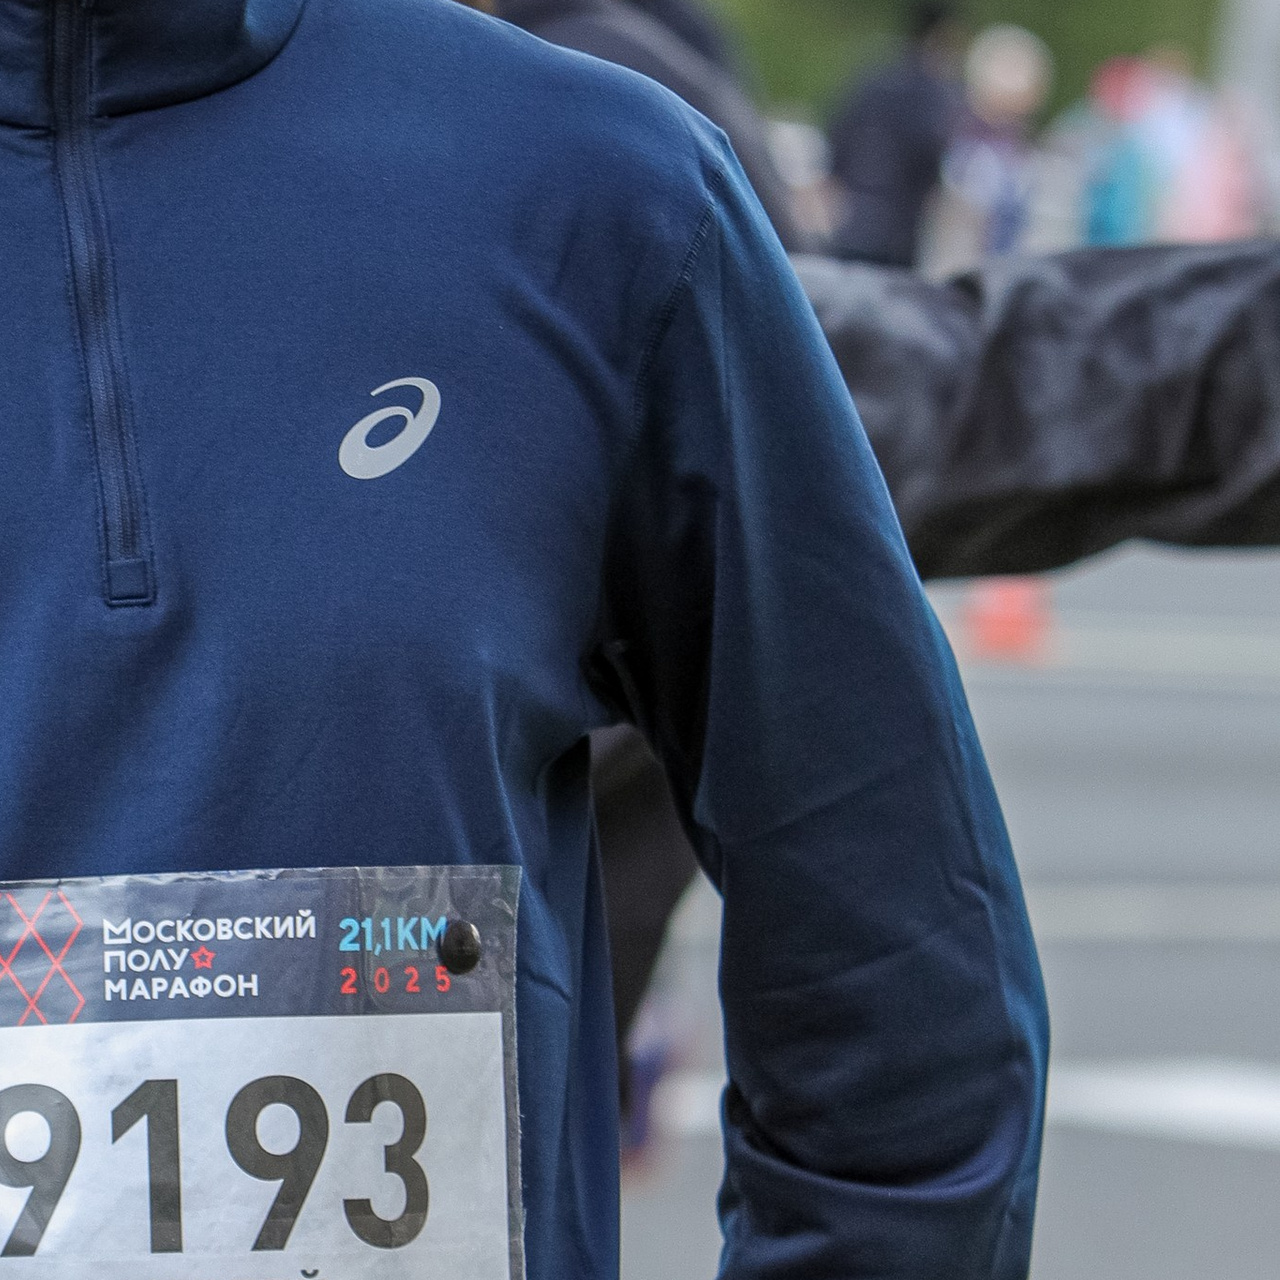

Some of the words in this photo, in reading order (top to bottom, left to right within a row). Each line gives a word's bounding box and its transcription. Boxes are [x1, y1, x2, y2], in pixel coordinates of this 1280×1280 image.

[102, 909, 316, 945] МОСКОВСКИЙ
[104, 948, 189, 973] ПОЛУ
[104, 974, 259, 1001] МАРАФОН
